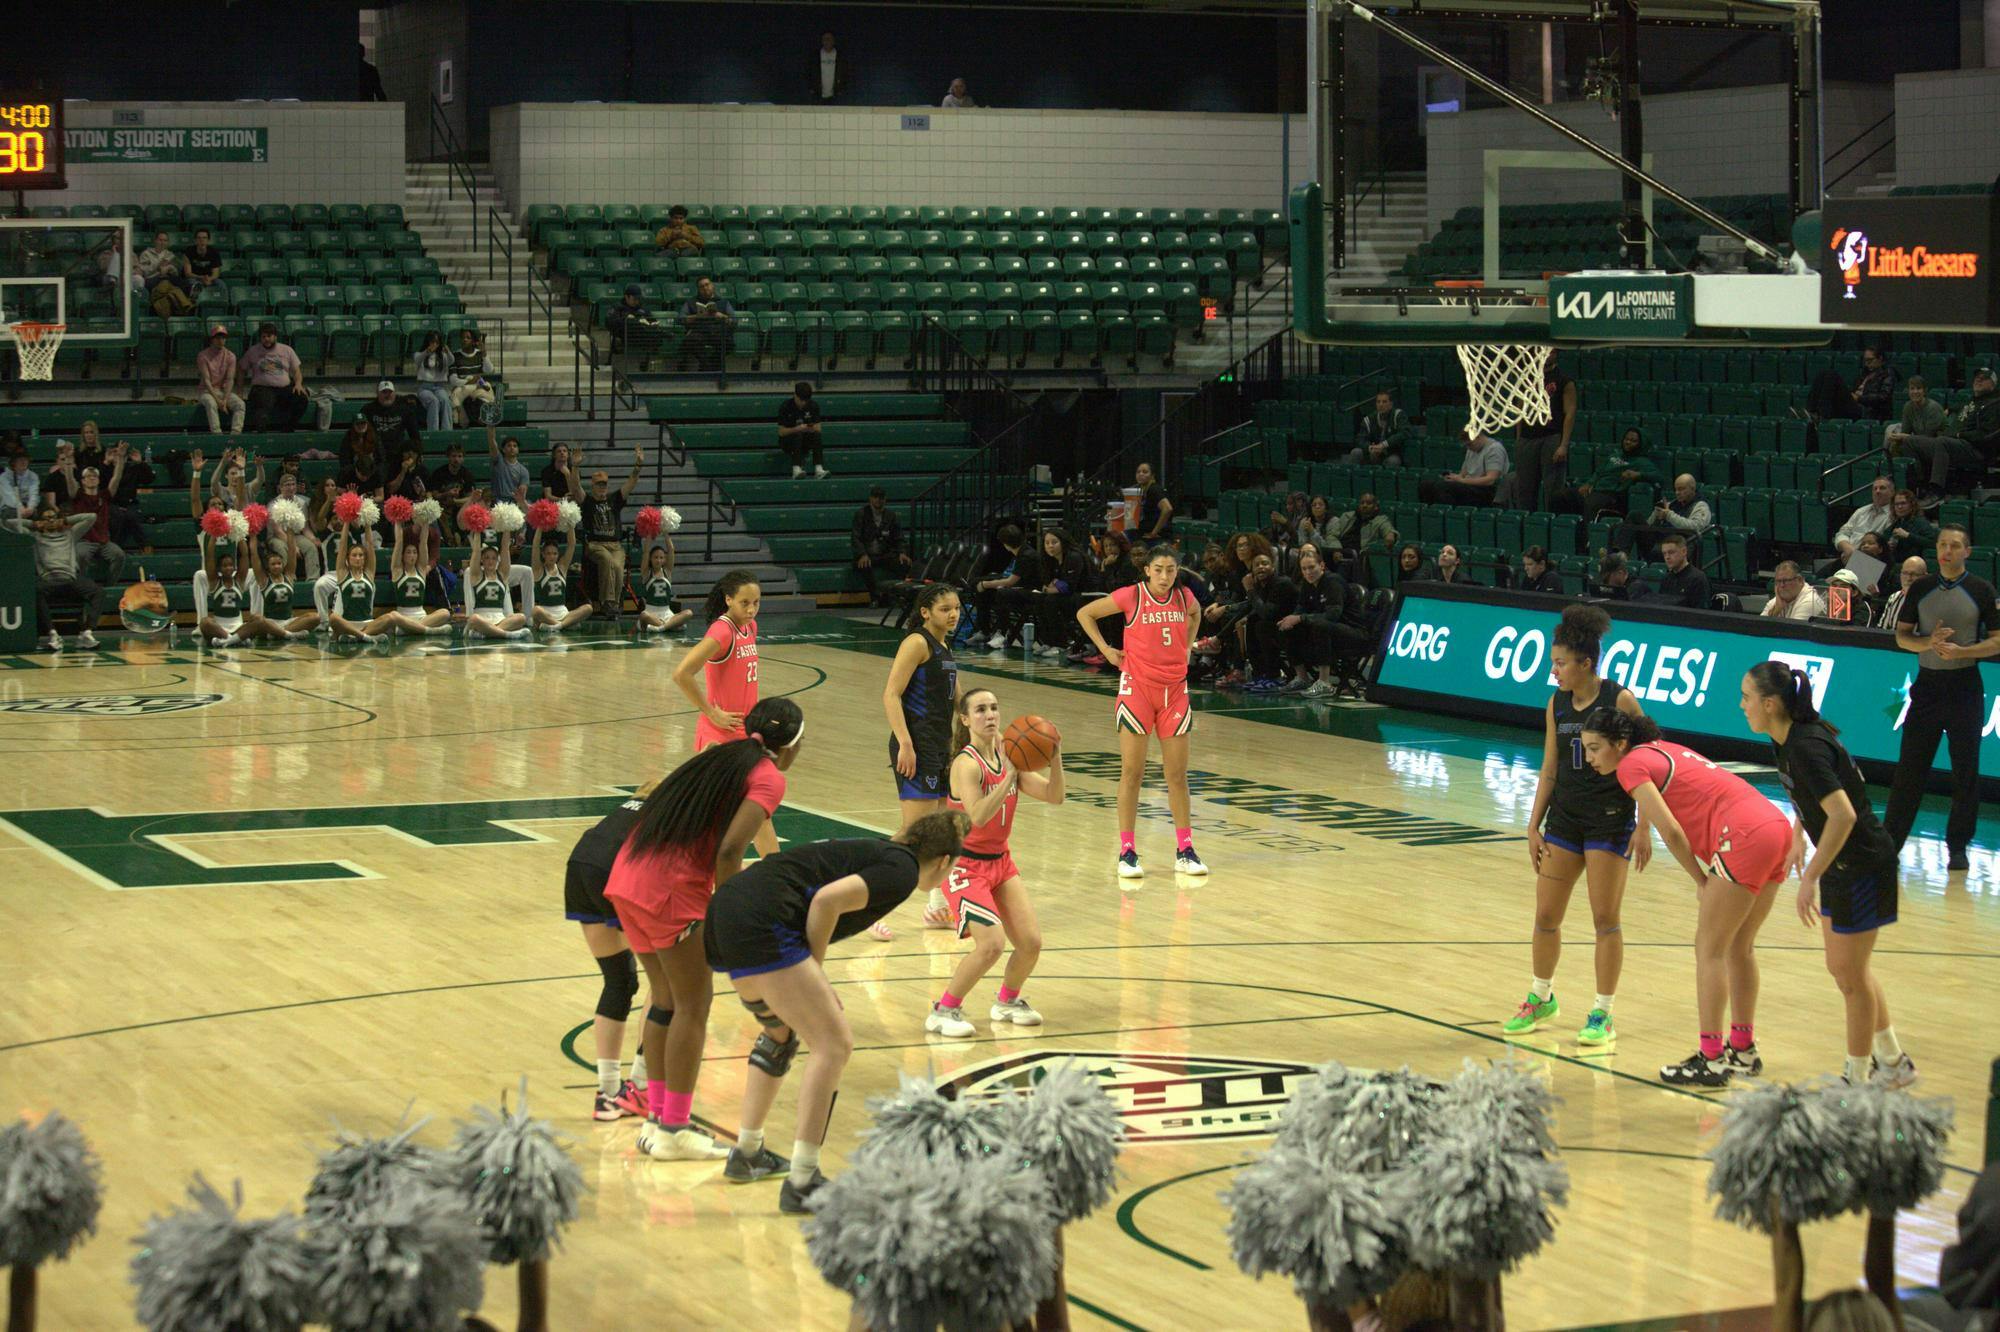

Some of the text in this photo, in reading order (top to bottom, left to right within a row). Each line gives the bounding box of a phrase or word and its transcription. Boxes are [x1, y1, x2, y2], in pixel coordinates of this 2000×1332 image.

[1, 104, 51, 128] 4:00
[119, 112, 138, 122] 113
[907, 117, 925, 127] 112
[114, 130, 186, 148] STUDENT
[191, 130, 257, 148] SECTION
[252, 149, 264, 162] E
[1867, 246, 1977, 278] Little Caesars
[1557, 291, 1615, 319] KIA
[1616, 307, 1676, 320] KIA YPSILANTI
[274, 587, 289, 603] E
[351, 582, 366, 598] E
[405, 581, 420, 598] E
[484, 585, 499, 600] E
[548, 580, 562, 596] E
[653, 581, 667, 597] E
[221, 592, 236, 608] E
[1142, 611, 1185, 625] EASTERN
[1161, 626, 1172, 646] 5
[746, 661, 758, 683] 23
[1485, 626, 1546, 683] GO
[1547, 640, 1718, 708] GLES!
[1001, 802, 1007, 827] 1
[1203, 792, 1530, 847] GERVIN
[949, 866, 970, 894] E
